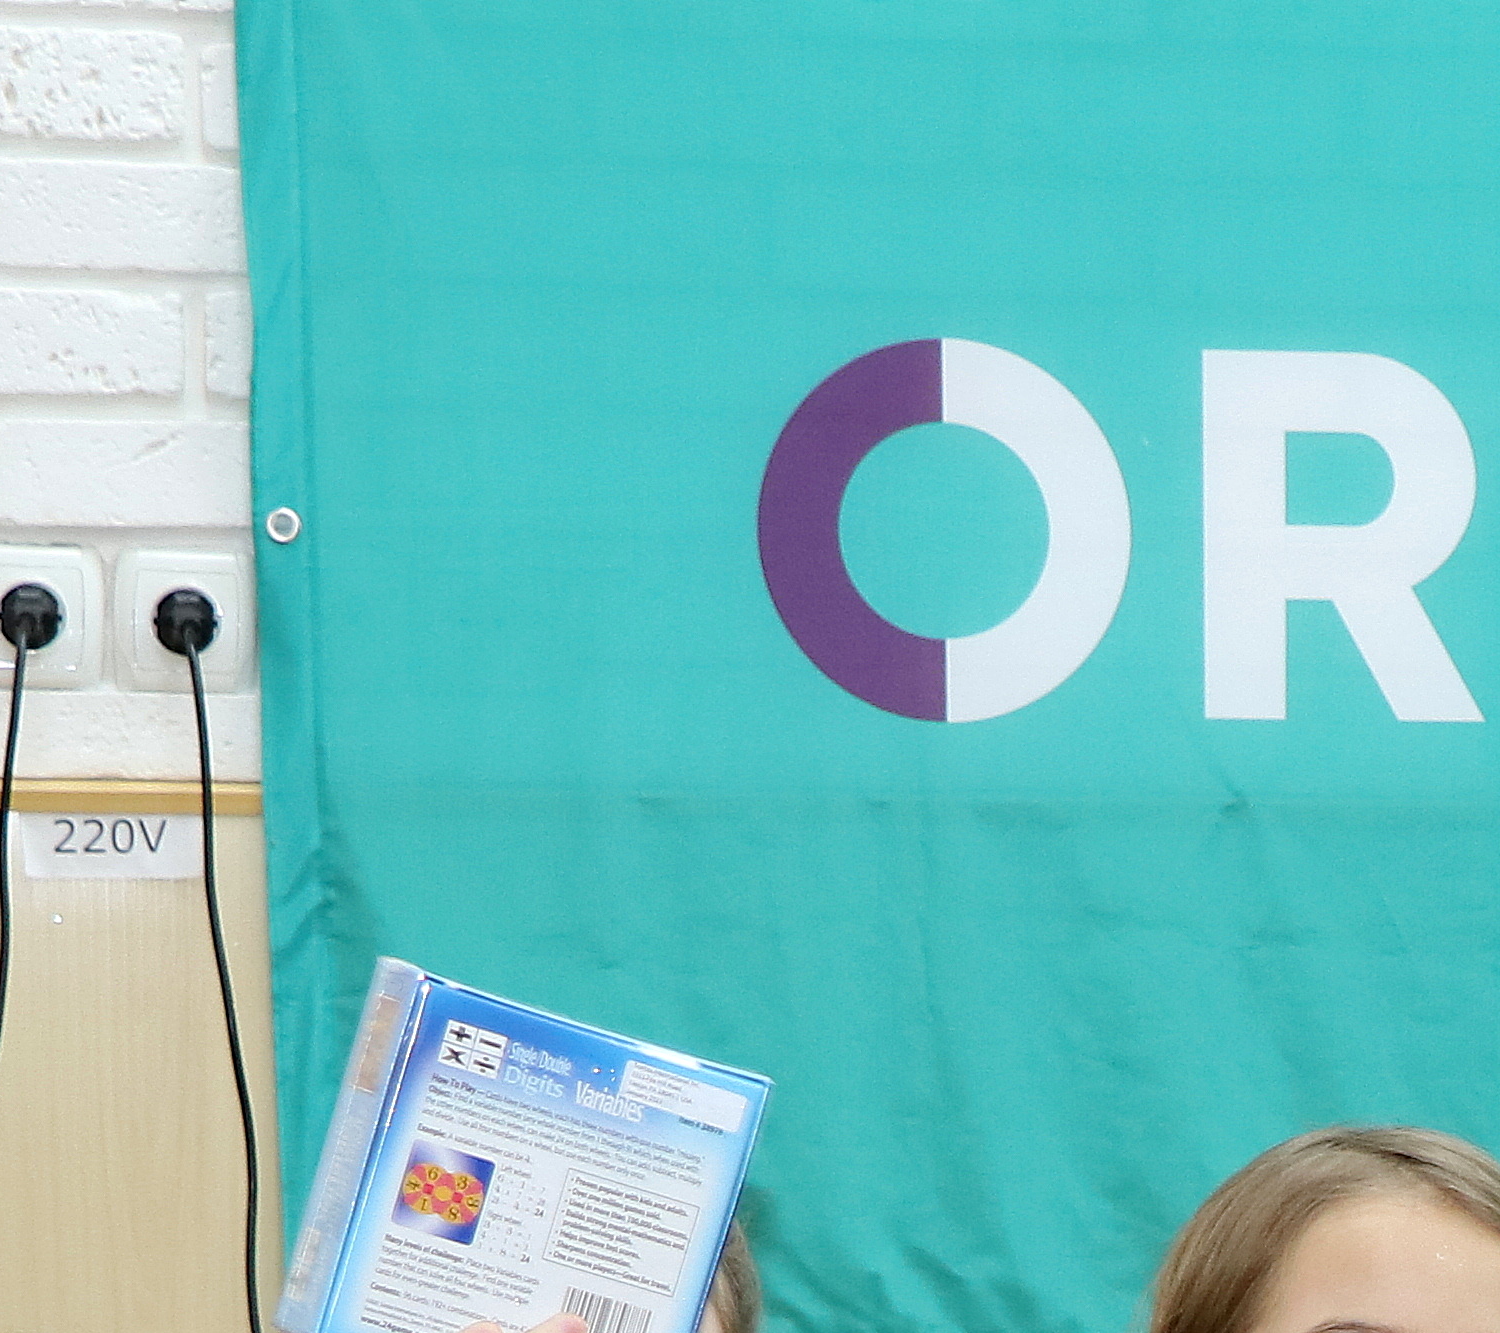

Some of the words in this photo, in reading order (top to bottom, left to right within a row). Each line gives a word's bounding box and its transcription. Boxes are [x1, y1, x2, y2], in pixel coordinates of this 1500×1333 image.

[54, 819, 167, 854] 220V
[502, 1065, 565, 1103] Digits
[574, 1079, 647, 1123] Variables
